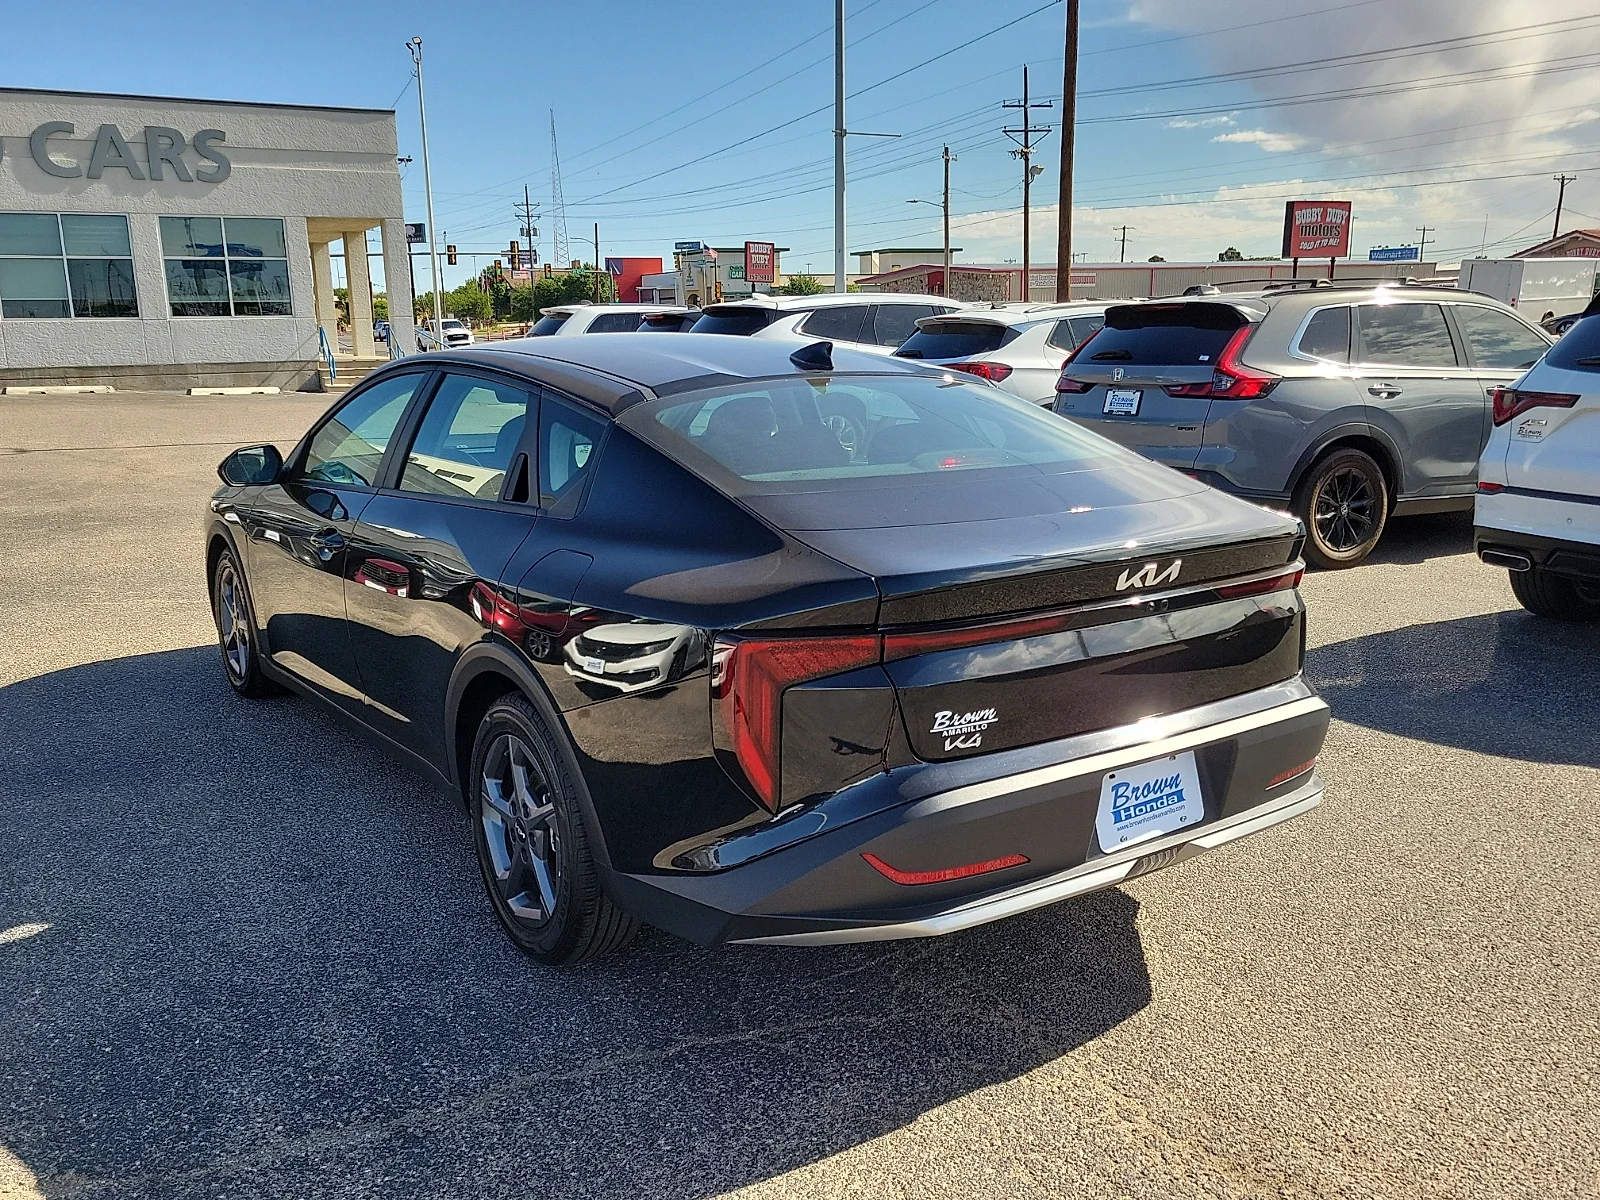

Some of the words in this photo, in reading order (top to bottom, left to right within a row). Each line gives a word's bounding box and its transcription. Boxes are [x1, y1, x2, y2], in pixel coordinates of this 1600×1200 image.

[30, 121, 231, 183] CARS
[1295, 207, 1323, 225] BOBBY
[1326, 207, 1348, 225] DUBY
[1300, 223, 1340, 237] motors
[750, 244, 772, 254] BOBBY
[1300, 241, 1314, 250] SOLD
[1314, 240, 1320, 248] IT
[1320, 239, 1328, 247] TO
[751, 254, 769, 264] DUBY
[1371, 250, 1401, 259] Walmart
[1517, 426, 1542, 436] Brown
[933, 707, 997, 729] Brown
[941, 723, 988, 737] AMARILLO
[944, 733, 982, 751] K4
[1111, 772, 1182, 810] Brown
[1119, 795, 1178, 821] Honda
